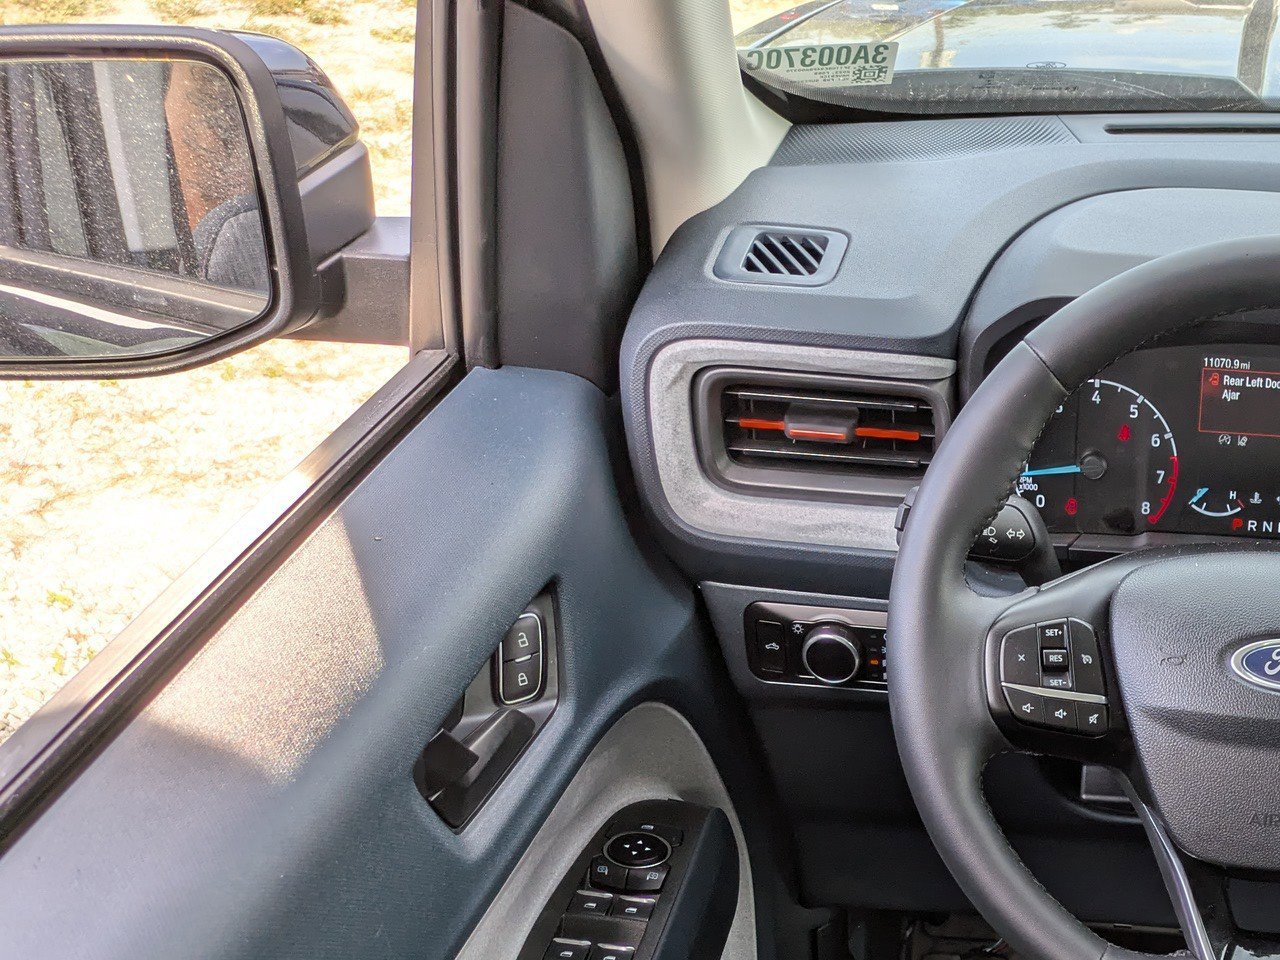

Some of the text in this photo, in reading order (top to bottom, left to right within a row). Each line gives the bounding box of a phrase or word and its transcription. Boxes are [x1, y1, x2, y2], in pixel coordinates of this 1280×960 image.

[1223, 375, 1244, 386] Rear
[1246, 377, 1263, 388] Left
[1091, 391, 1101, 404] 4
[1222, 389, 1240, 401] Ajar
[1129, 405, 1139, 418] 5
[1151, 434, 1161, 447] 6
[1156, 470, 1165, 484] 7
[1036, 495, 1045, 507] 0
[1229, 491, 1237, 500] H
[1141, 502, 1150, 515] 8
